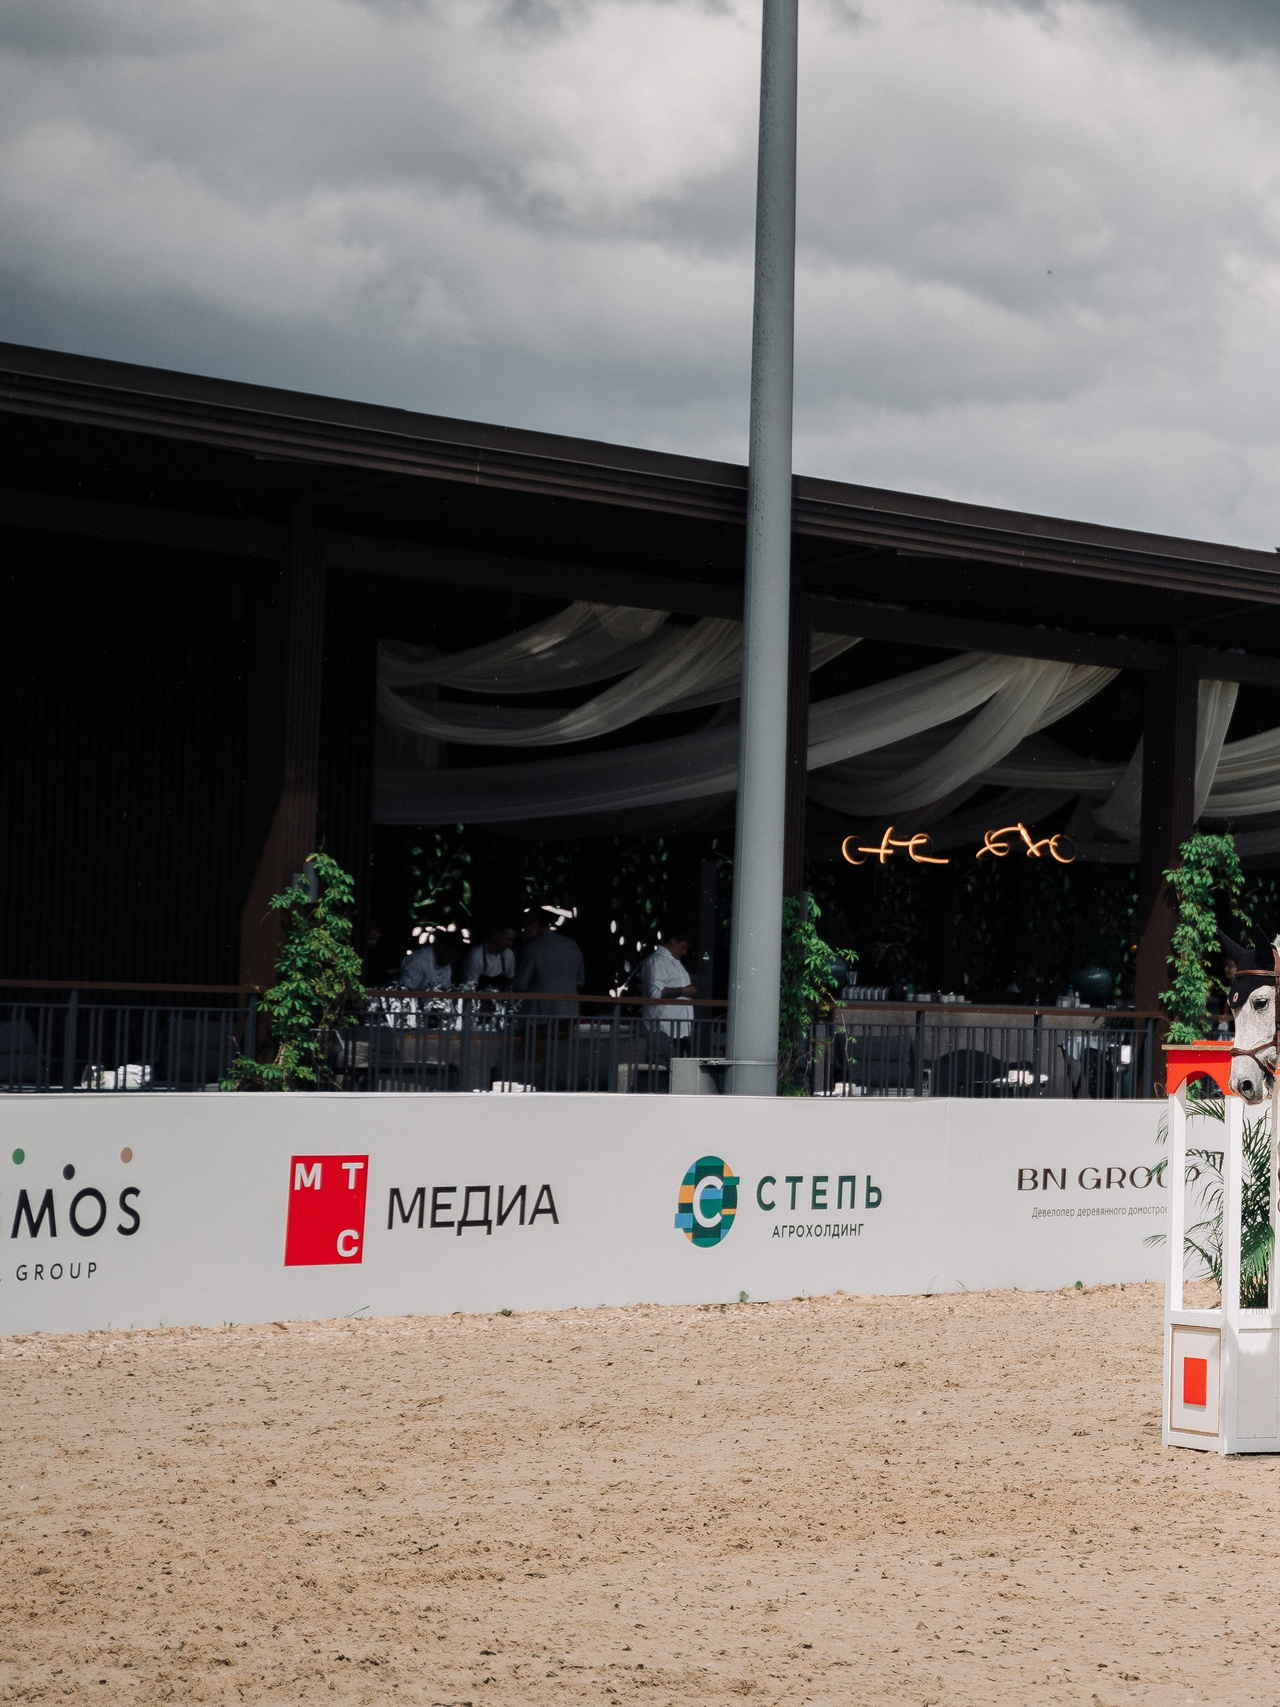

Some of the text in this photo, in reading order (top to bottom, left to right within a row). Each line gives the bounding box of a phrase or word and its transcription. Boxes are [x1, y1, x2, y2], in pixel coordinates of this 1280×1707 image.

[1017, 1167, 1067, 1191] BN
[756, 1174, 883, 1212] СТЕПЬ
[0, 1186, 141, 1239] MOS
[387, 1184, 560, 1237] МЕДИА
[1031, 1206, 1076, 1219] Девелопер
[1076, 1205, 1127, 1219] деревянного
[771, 1223, 865, 1239] АГРОХОЛДИНГ
[16, 1261, 98, 1282] GROUP
